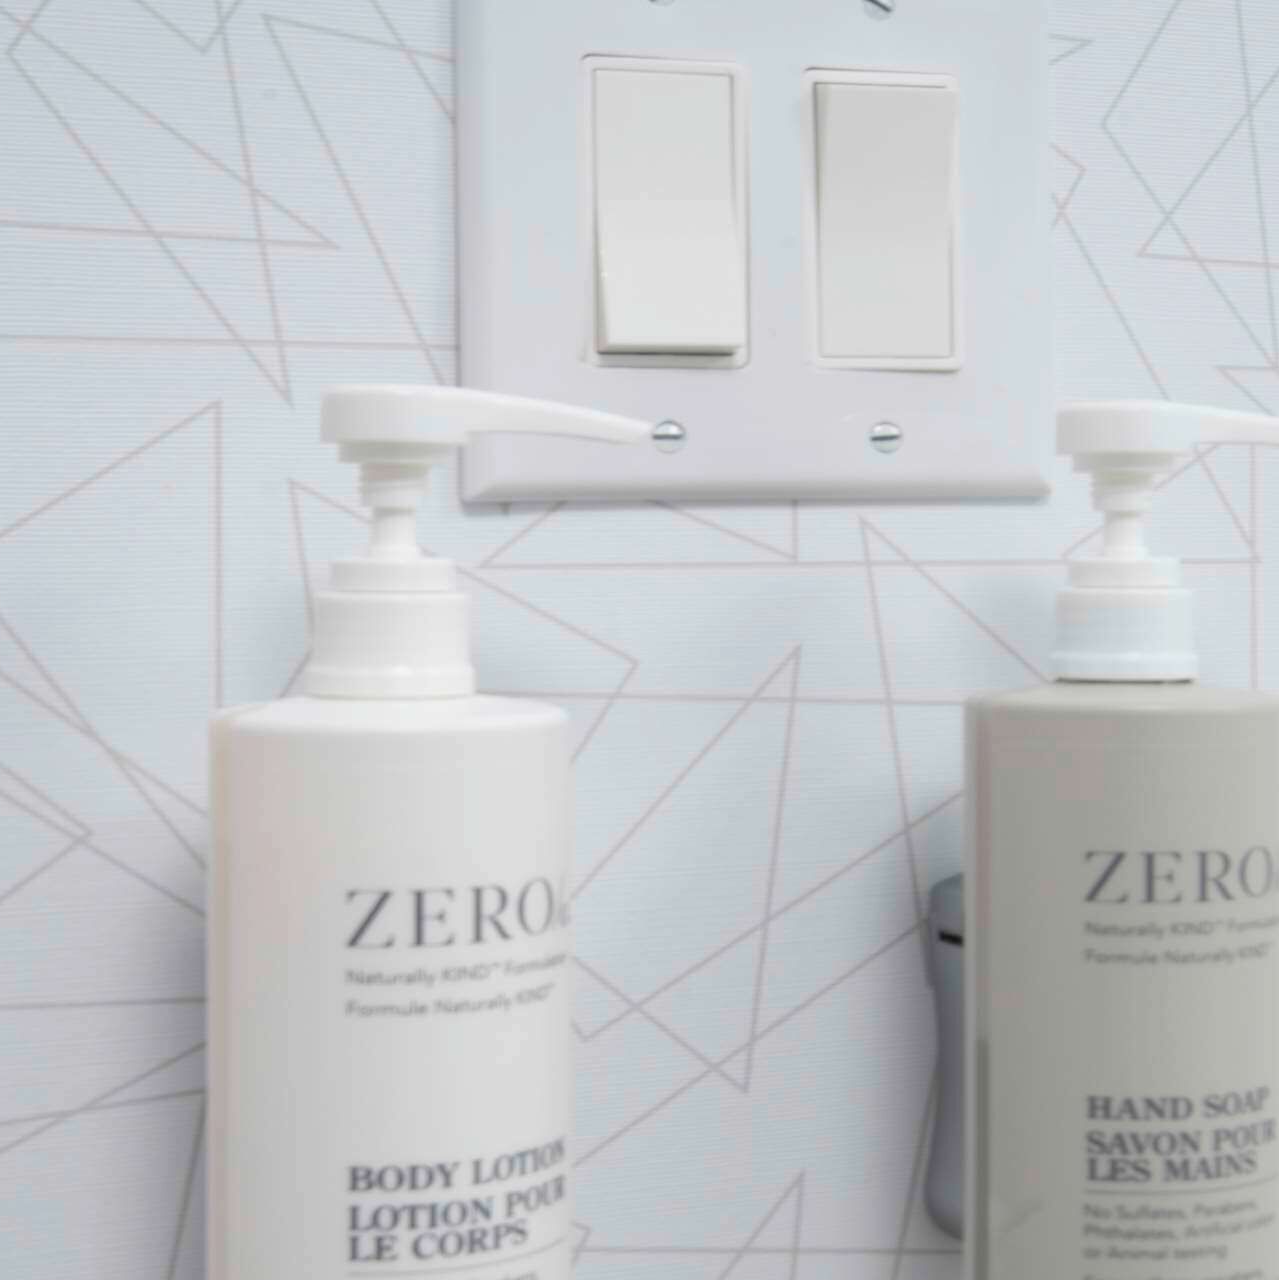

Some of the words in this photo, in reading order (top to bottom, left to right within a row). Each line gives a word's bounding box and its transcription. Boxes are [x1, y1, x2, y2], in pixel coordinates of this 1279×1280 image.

[1084, 845, 1276, 904] ZERO
[345, 877, 554, 949] ZERO
[344, 968, 435, 988] Naturally
[344, 1000, 428, 1017] Formule
[1085, 1094, 1195, 1121] HAND
[1200, 1084, 1269, 1119] SOAP
[1085, 1128, 1202, 1156] SAVON
[1212, 1118, 1277, 1151] POUR
[347, 1162, 460, 1192] BODY
[1086, 1156, 1152, 1183] LES
[1163, 1150, 1258, 1183] MAINS
[348, 1197, 495, 1232] LOTION
[348, 1235, 398, 1262] LE
[412, 1220, 528, 1260] CORPS
